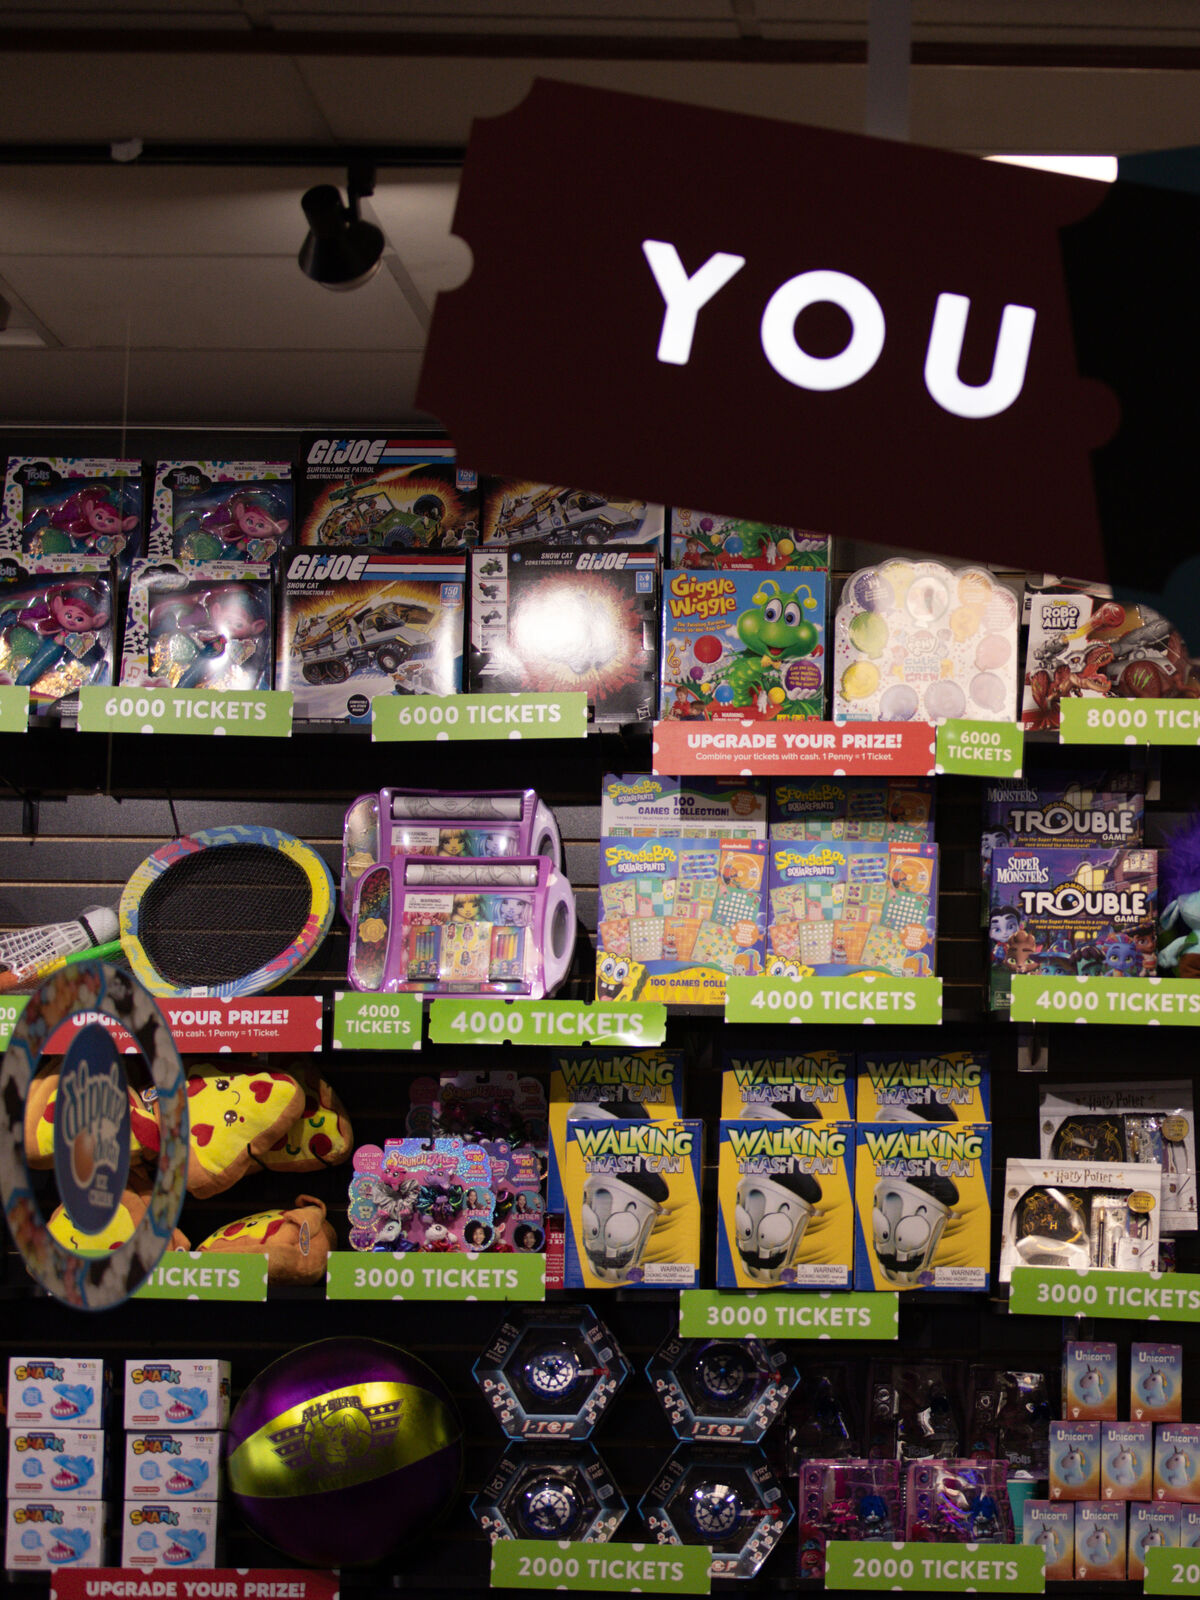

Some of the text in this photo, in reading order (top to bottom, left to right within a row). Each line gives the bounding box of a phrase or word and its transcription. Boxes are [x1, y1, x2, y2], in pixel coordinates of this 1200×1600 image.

[641, 238, 1037, 419] YOU
[351, 466, 375, 474] PATROL
[286, 582, 320, 590] SNOW CAT
[670, 572, 737, 601] Giggle
[669, 596, 737, 620] Wiggle
[1042, 617, 1078, 629] ALIVE
[105, 698, 266, 720] 6000 TICKETS
[399, 703, 561, 725] 6000 TICKETS
[1087, 709, 1147, 728] 8000
[688, 734, 902, 748] UPGRADE YOUR PRIZE!
[960, 731, 1000, 746] 6000
[694, 752, 735, 762] Combine
[736, 752, 753, 761] your
[753, 752, 780, 760] tickets
[781, 752, 798, 760] with
[828, 752, 853, 762] Penny
[867, 752, 893, 760] Ticket.
[948, 746, 1012, 762] TICKETS
[674, 796, 695, 807] 100
[638, 806, 730, 816] GAMES COLLECTION!
[617, 862, 666, 874] SQUAREPANTS
[1008, 856, 1040, 871] SUPER
[996, 868, 1049, 883] MONSTERS
[1020, 888, 1146, 917] TROUBLE
[1114, 915, 1139, 923] GAME
[750, 990, 916, 1010] 4000 TICKETS
[1036, 990, 1200, 1013] 4000 TICKETS
[168, 1010, 288, 1025] YOUR PRIZE!
[358, 1005, 400, 1018] 4000
[346, 1020, 410, 1034] TICKETS
[451, 1011, 646, 1038] 4000 TICKETS
[573, 1126, 693, 1155] WALKING
[584, 1156, 685, 1173] TRASH CAN
[1055, 1168, 1113, 1185] Harry Potter
[354, 1268, 518, 1288] 3000 TICKETS
[1037, 1283, 1200, 1309] 3000 TICKETS
[707, 1306, 871, 1326] 3000 TICKETS
[1075, 1349, 1112, 1364] Unicorn
[15, 1366, 65, 1381] SHARK
[518, 1557, 683, 1581] 2000 TICKETS
[853, 1558, 1018, 1580] 2000 TICKETS
[86, 1581, 305, 1597] UPGRADE YOUR PRIZE!
